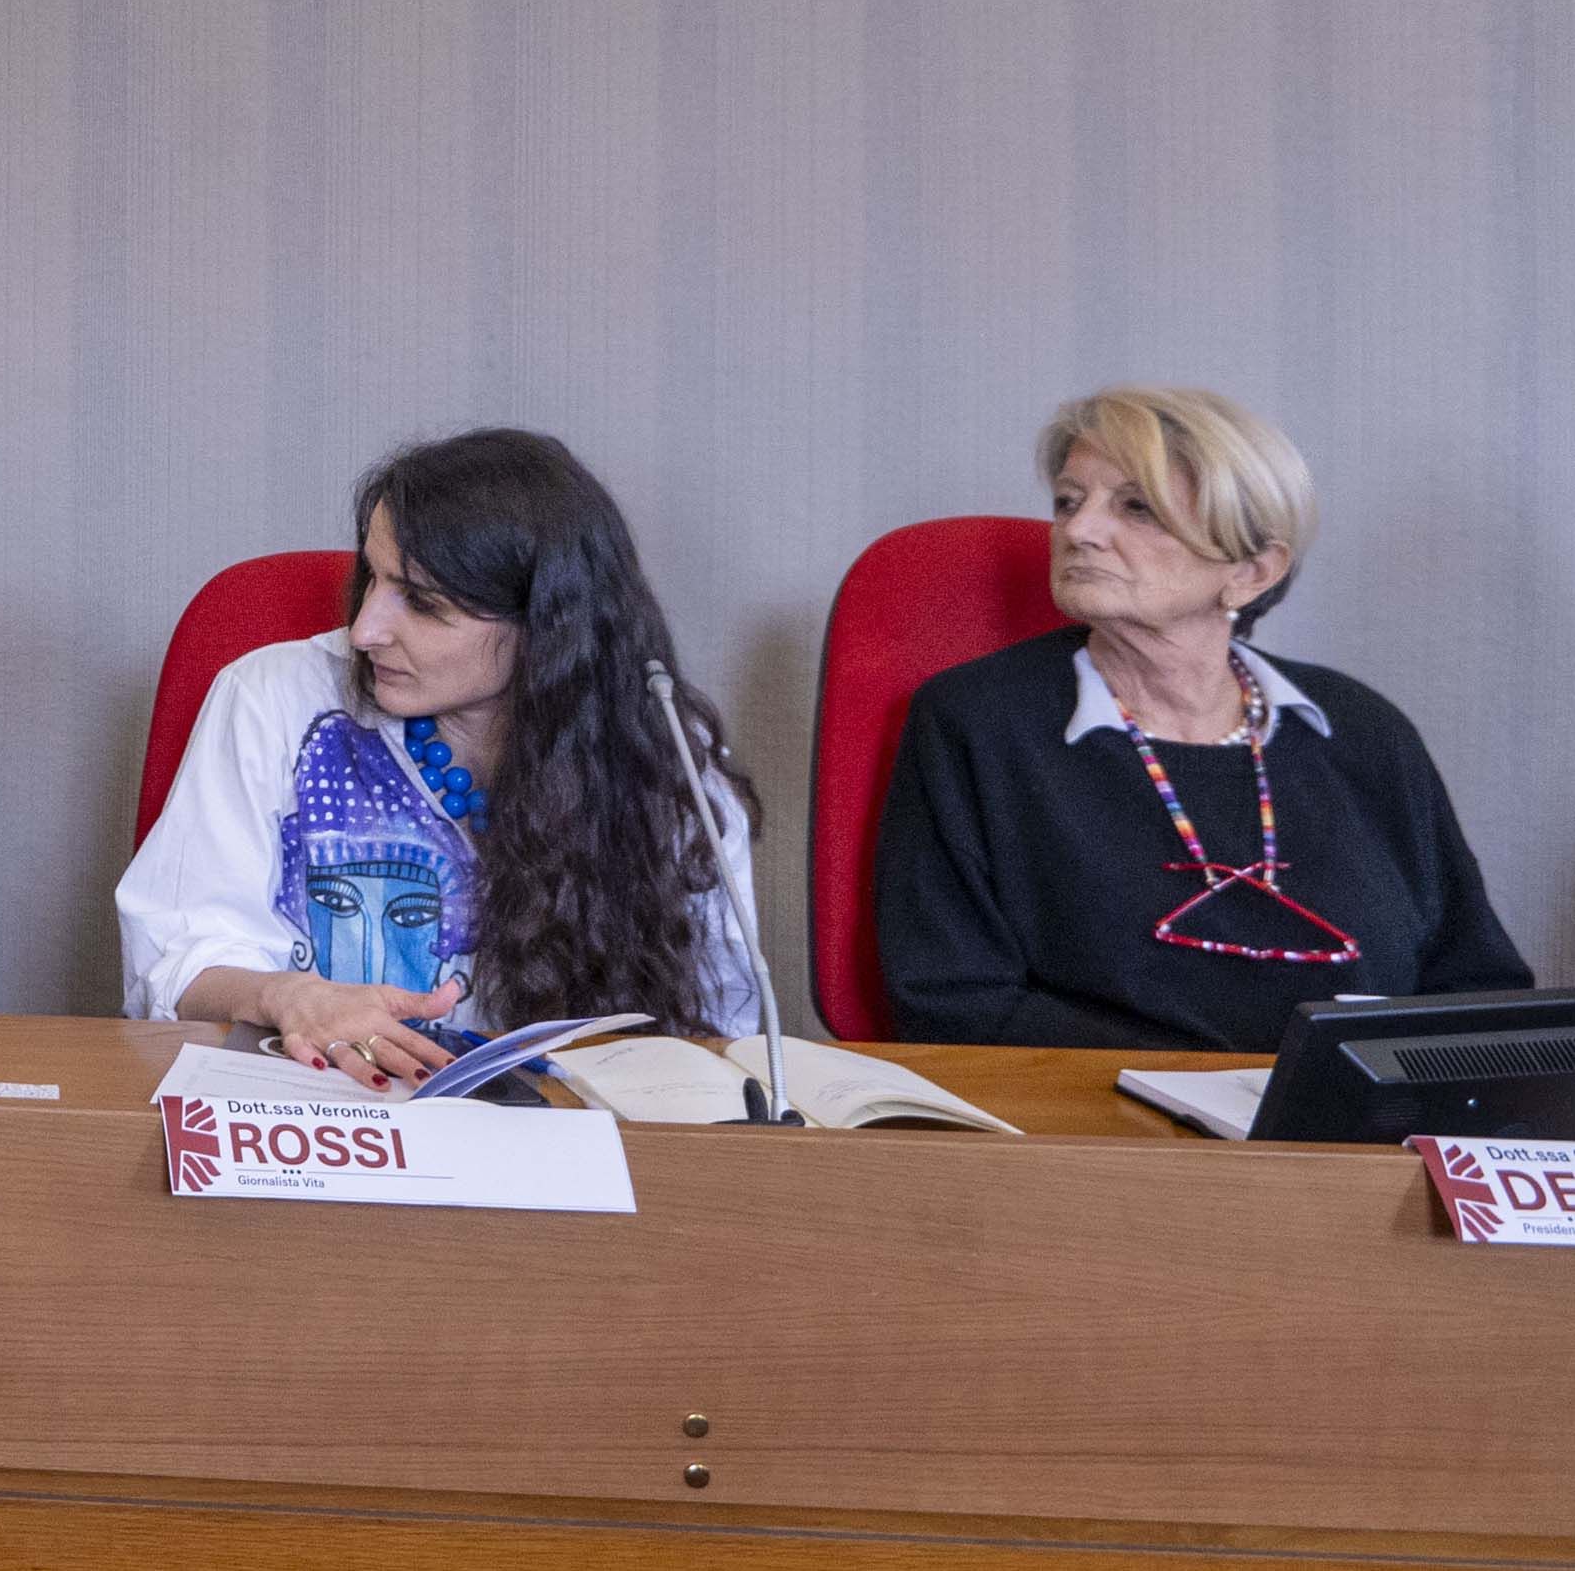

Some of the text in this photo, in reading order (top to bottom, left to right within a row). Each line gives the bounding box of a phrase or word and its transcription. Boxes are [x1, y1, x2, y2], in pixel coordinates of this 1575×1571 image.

[228, 1100, 391, 1120] Dott.ssa Veronica
[229, 1122, 407, 1170] ROSSI
[1486, 1146, 1570, 1162] Dott.ssa
[238, 1175, 325, 1188] Giornalista Vita
[1496, 1170, 1575, 1212] DE
